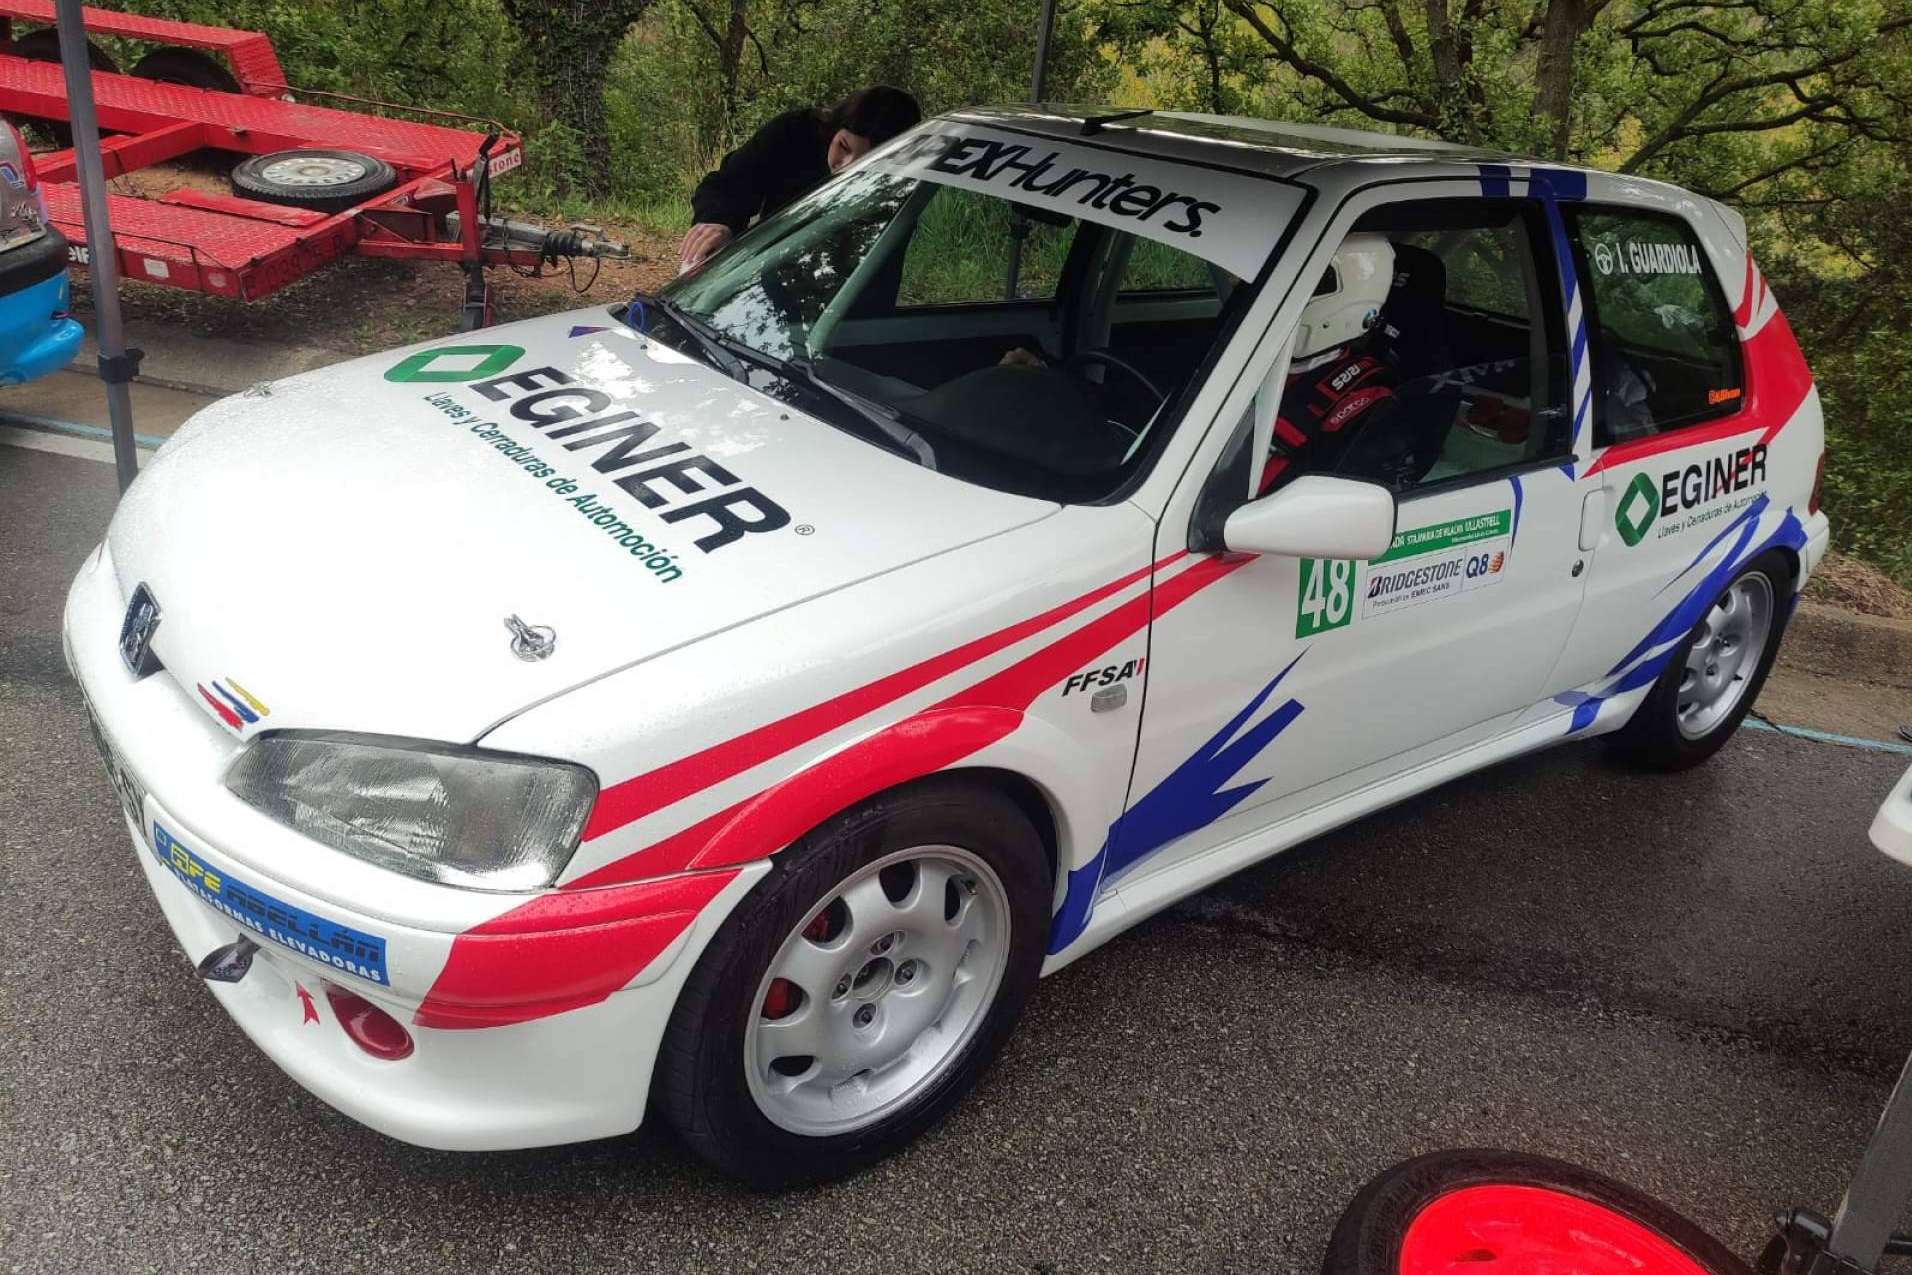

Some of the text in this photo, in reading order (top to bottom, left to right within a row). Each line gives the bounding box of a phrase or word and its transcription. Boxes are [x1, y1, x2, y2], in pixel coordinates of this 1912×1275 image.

[1616, 242, 1702, 274] I. GUARDIOLA
[423, 391, 470, 420] Llaves
[471, 421, 555, 479] Cerraduras
[545, 475, 578, 496] de
[570, 491, 683, 584] Automoción
[468, 366, 792, 554] EGINER
[1661, 443, 1768, 518] EGINER
[1301, 559, 1350, 629] 48
[1367, 553, 1489, 599] BRIDGESTONE Q8
[1061, 659, 1138, 697] FFSA
[267, 927, 382, 982] ELEVADORAS
